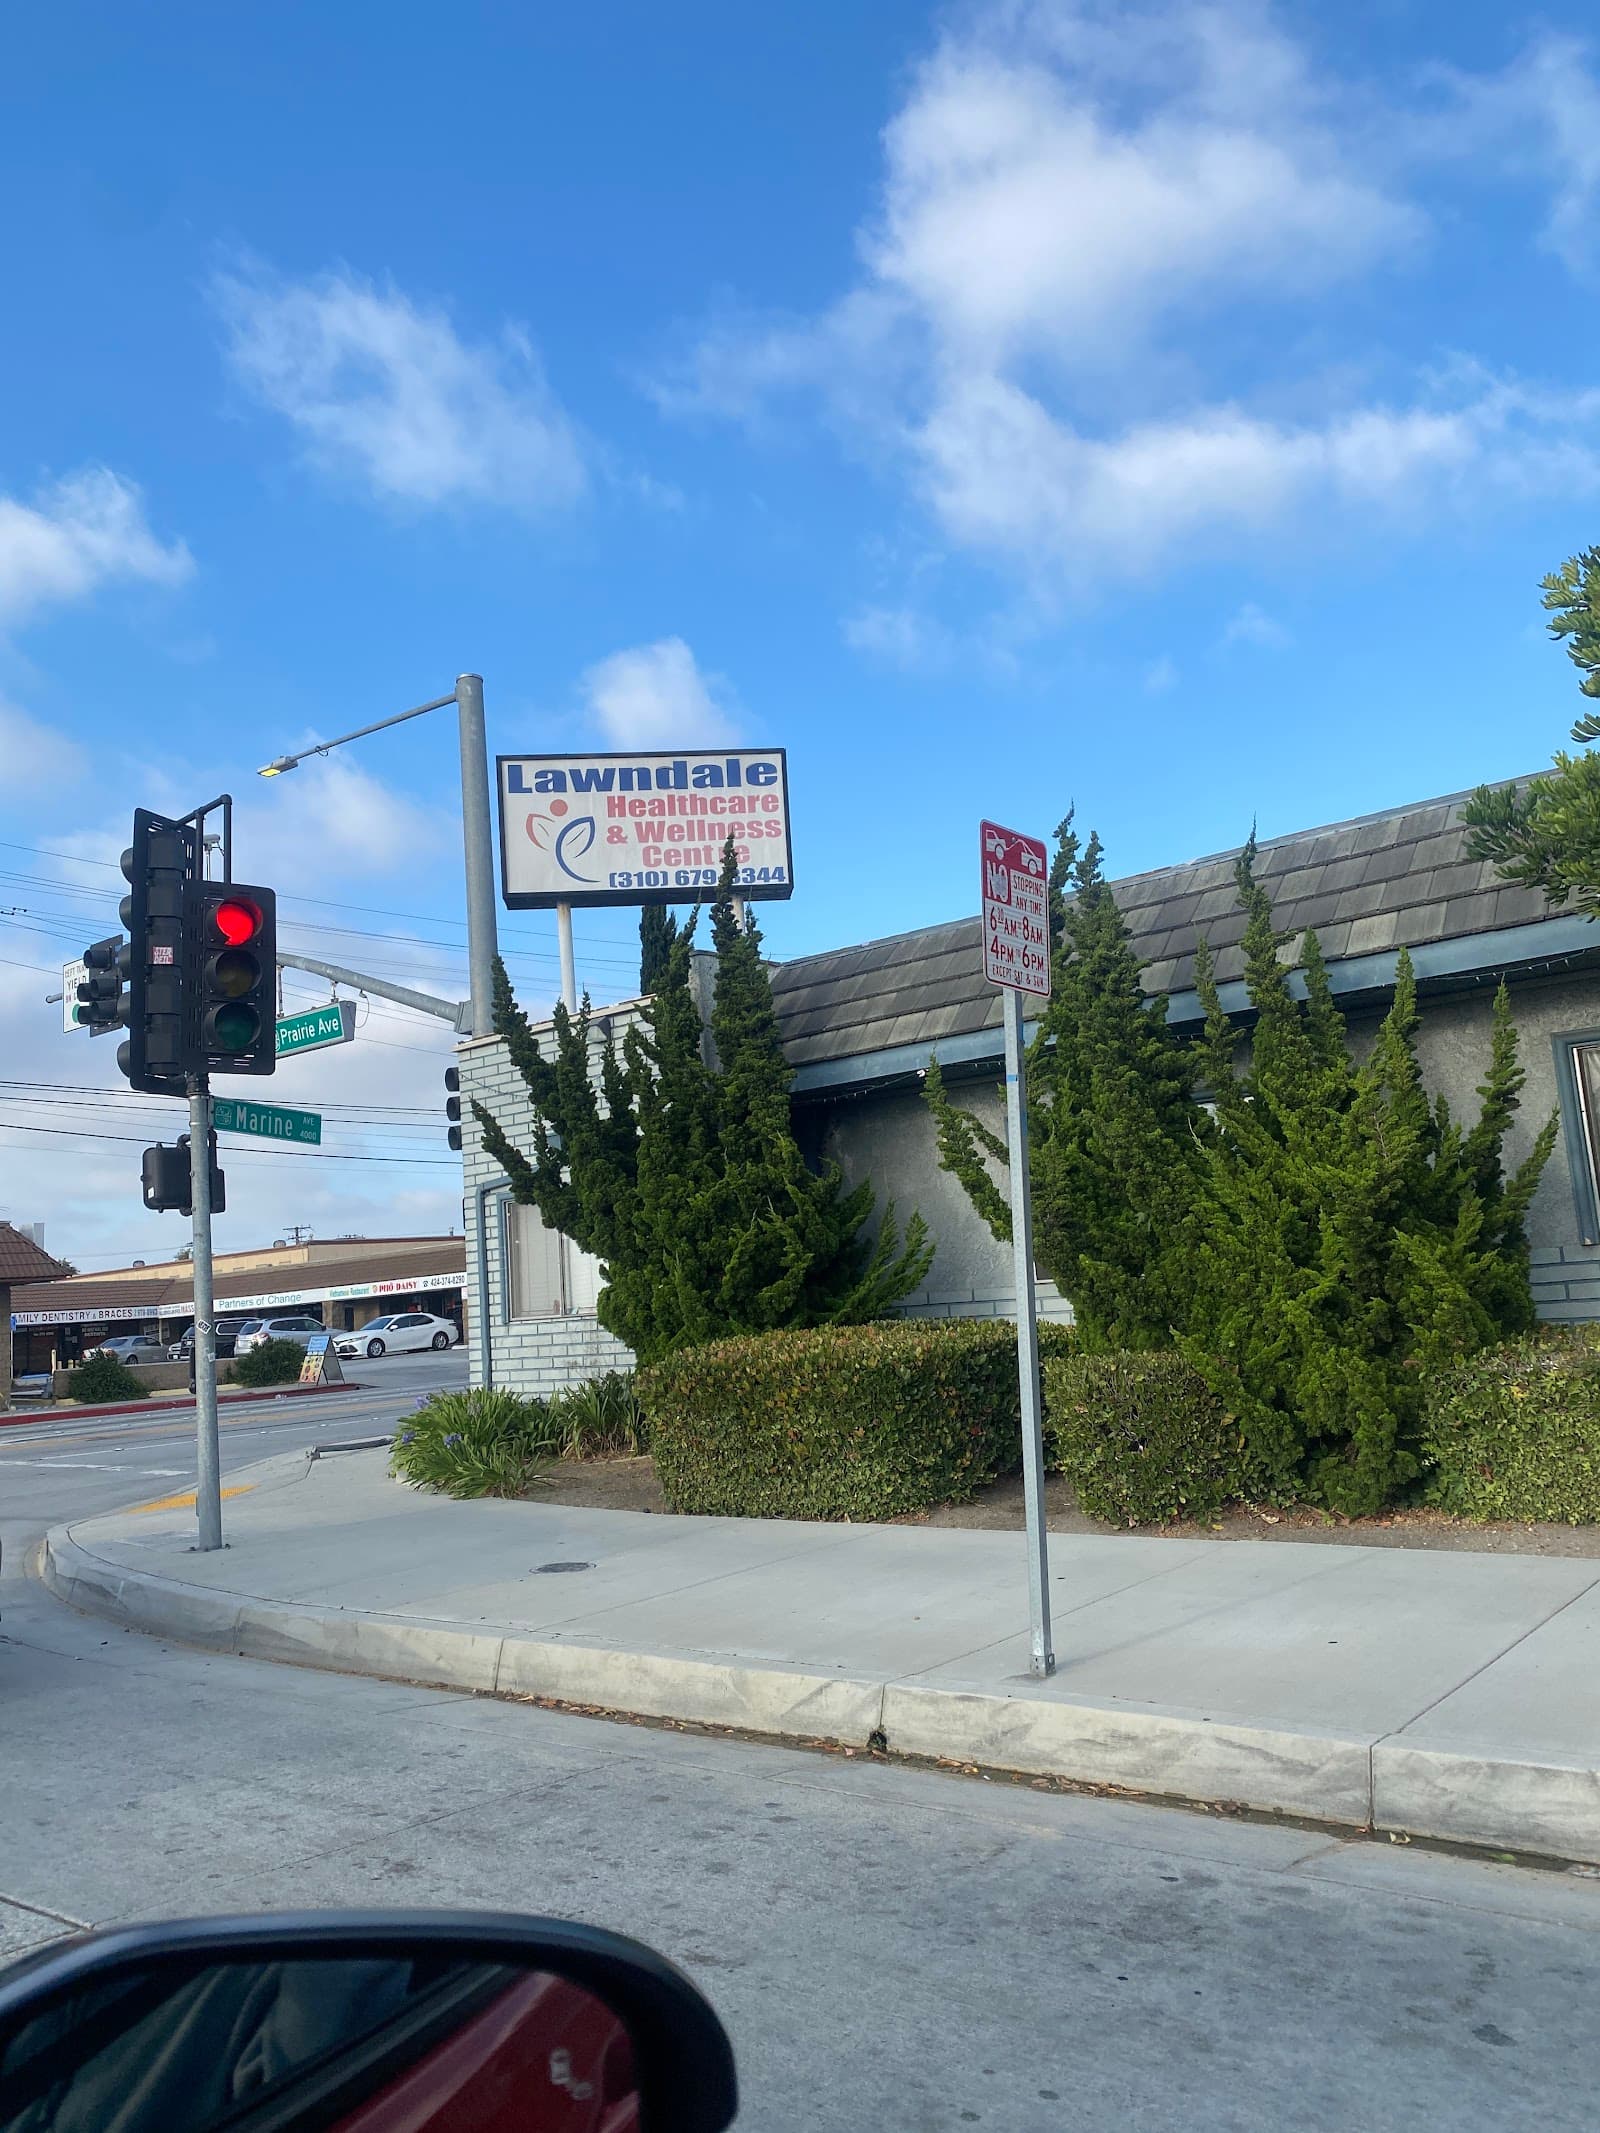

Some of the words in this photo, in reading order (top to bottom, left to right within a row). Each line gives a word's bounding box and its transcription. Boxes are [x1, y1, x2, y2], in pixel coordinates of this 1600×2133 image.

[507, 758, 778, 794] Lawndale
[606, 794, 780, 818] Healthcare
[606, 825, 628, 845] &
[635, 819, 782, 843] Wellness
[608, 870, 668, 889] (310)
[674, 866, 786, 886] 679344
[1013, 874, 1044, 898] STOPPING
[1015, 895, 1028, 912] ANY
[1029, 900, 1043, 917] TIME
[992, 963, 1012, 980] EXCEPT
[280, 1021, 316, 1045] Prairie
[318, 1017, 339, 1036] Ave
[236, 1104, 293, 1137] Marine
[302, 1116, 315, 1126] AVE
[396, 1280, 417, 1291] DAISY
[218, 1299, 254, 1309] Partners
[256, 1296, 265, 1306] of
[267, 1294, 302, 1305] Change
[14, 1312, 40, 1323] MILY
[41, 1311, 91, 1322] DENTISTRY
[98, 1308, 133, 1319] BRACES
